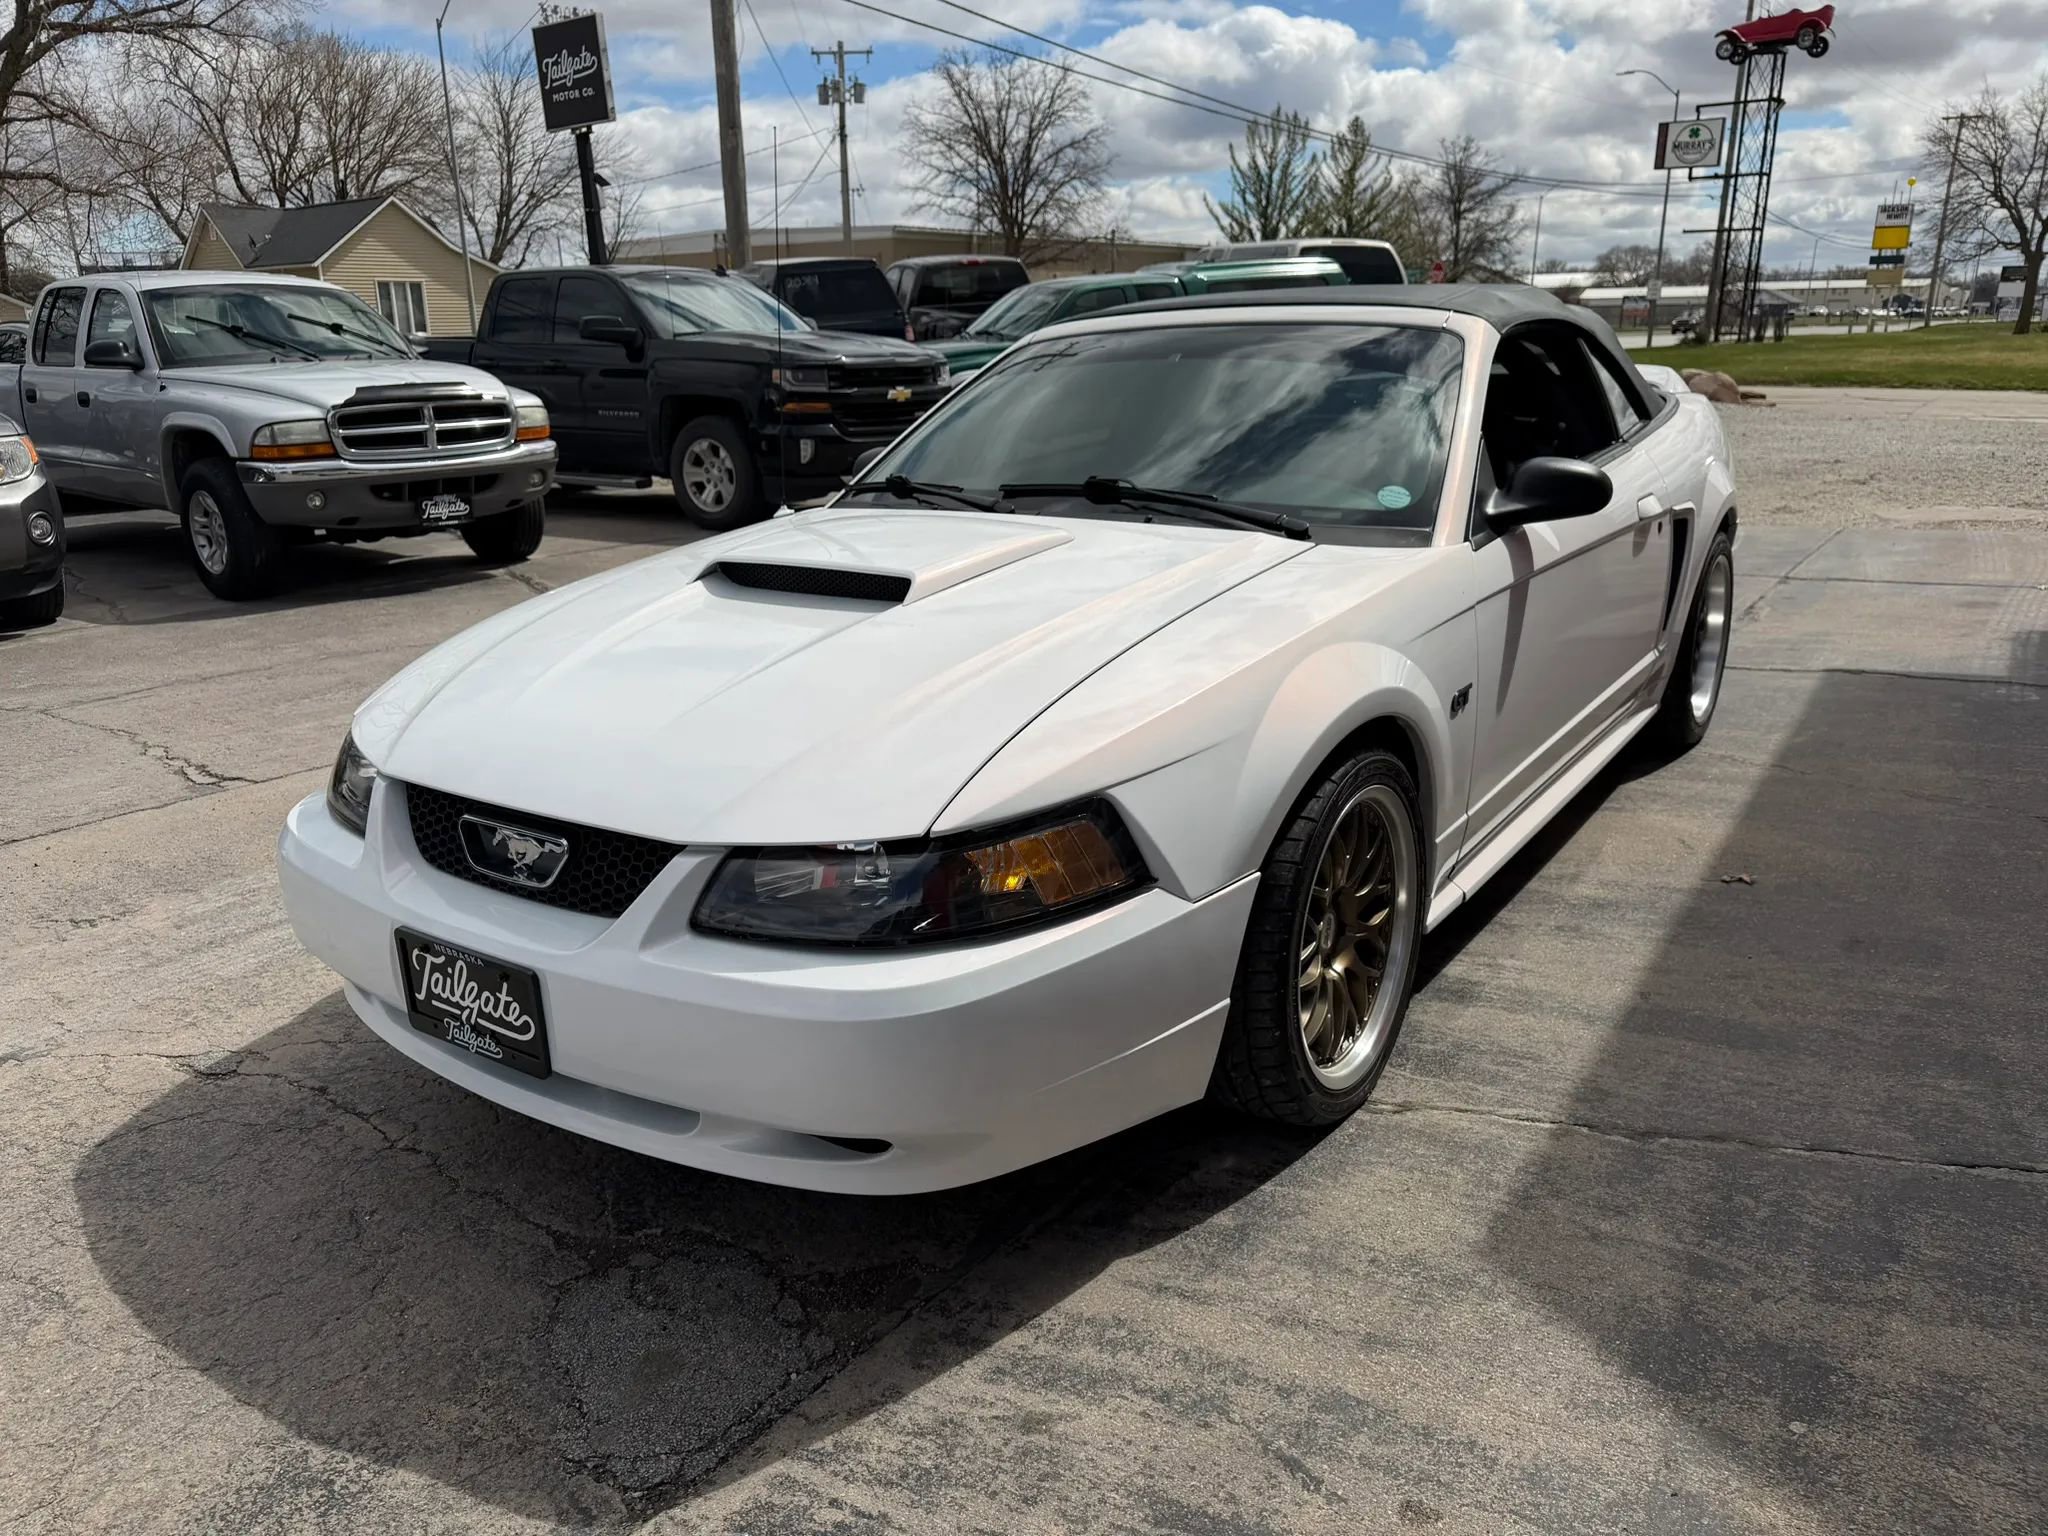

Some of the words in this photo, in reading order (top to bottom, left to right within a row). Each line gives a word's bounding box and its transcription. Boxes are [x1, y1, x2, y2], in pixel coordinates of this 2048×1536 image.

[542, 45, 598, 89] Tailgate
[552, 88, 580, 102] MOTOR
[1672, 139, 1716, 153] MURRAY'S
[1880, 204, 1909, 213] JACKSON
[1886, 212, 1908, 220] HEWITT
[422, 498, 470, 520] Tailgate
[1450, 682, 1473, 714] GT
[433, 943, 485, 967] NEBRASKA
[412, 947, 536, 1042] Tailgate
[443, 1017, 504, 1059] Tailgate
